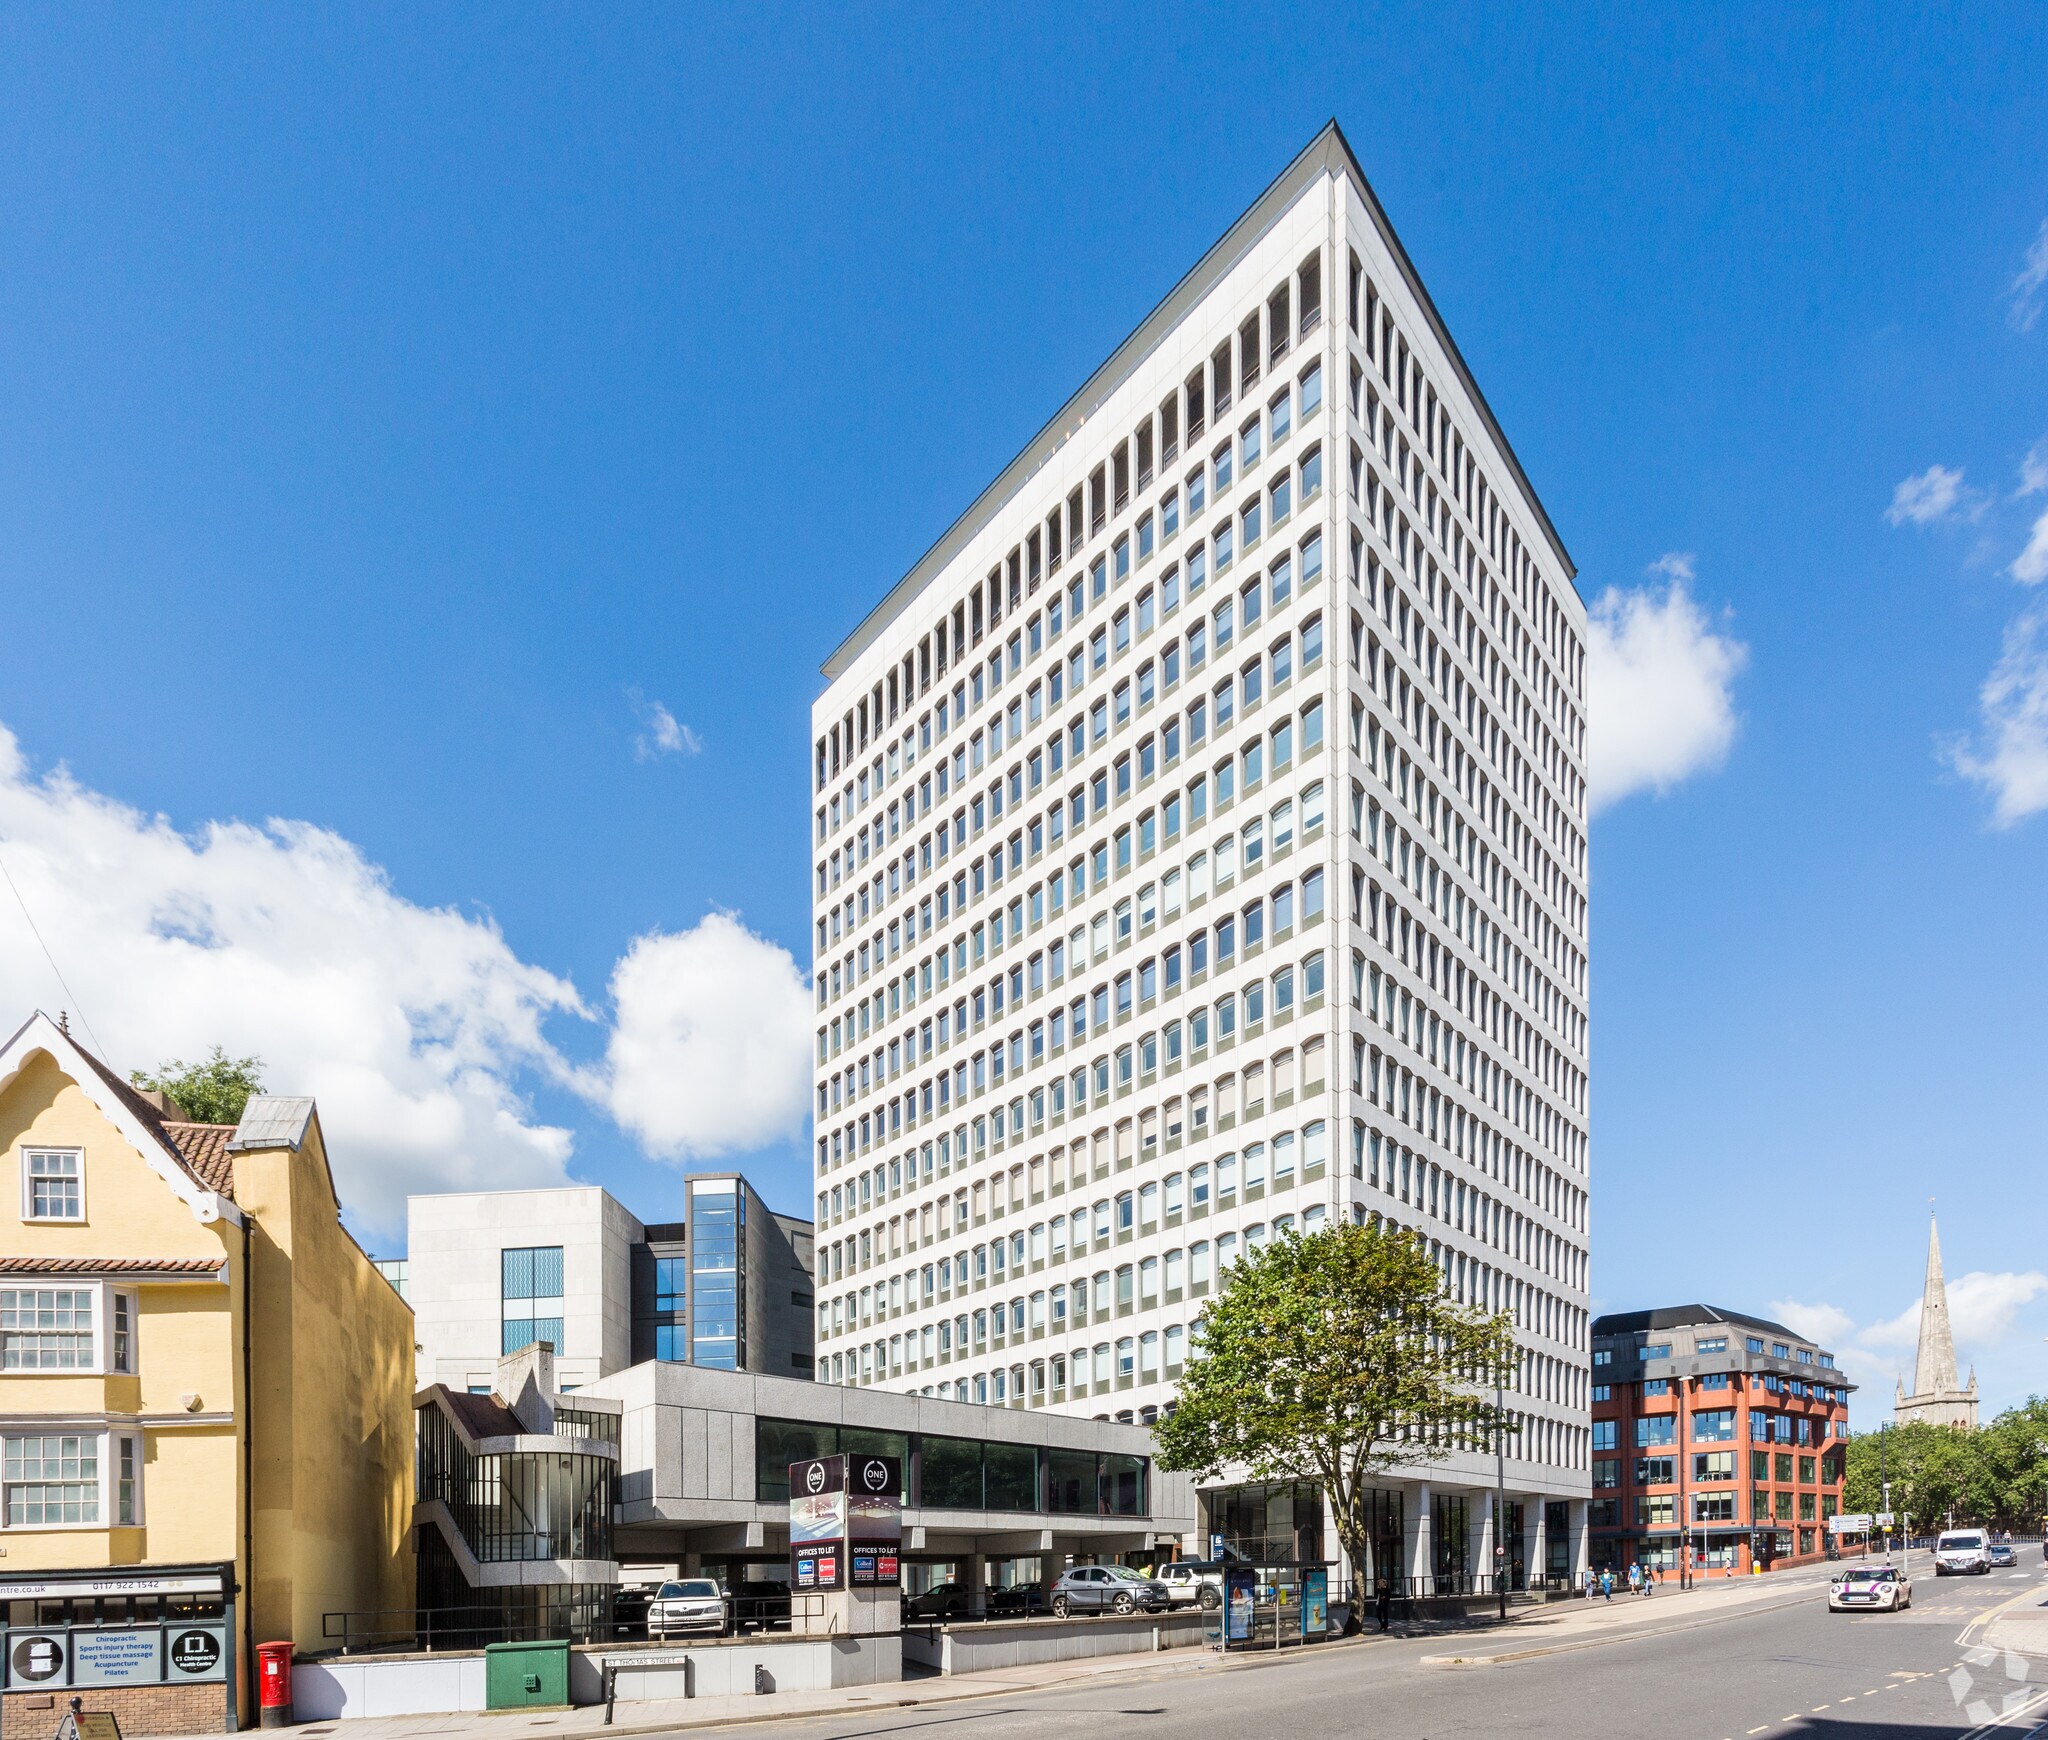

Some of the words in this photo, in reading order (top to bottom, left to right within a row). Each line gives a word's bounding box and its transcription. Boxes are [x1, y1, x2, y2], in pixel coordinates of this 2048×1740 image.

[809, 1472, 822, 1481] ONE
[867, 1470, 884, 1479] ONE
[798, 1548, 817, 1556] OFFICES
[826, 1546, 835, 1554] LET
[92, 1582, 113, 1590] 0117
[116, 1581, 133, 1589] 922
[137, 1580, 159, 1589] 1542
[95, 1635, 137, 1643] Chiropractic
